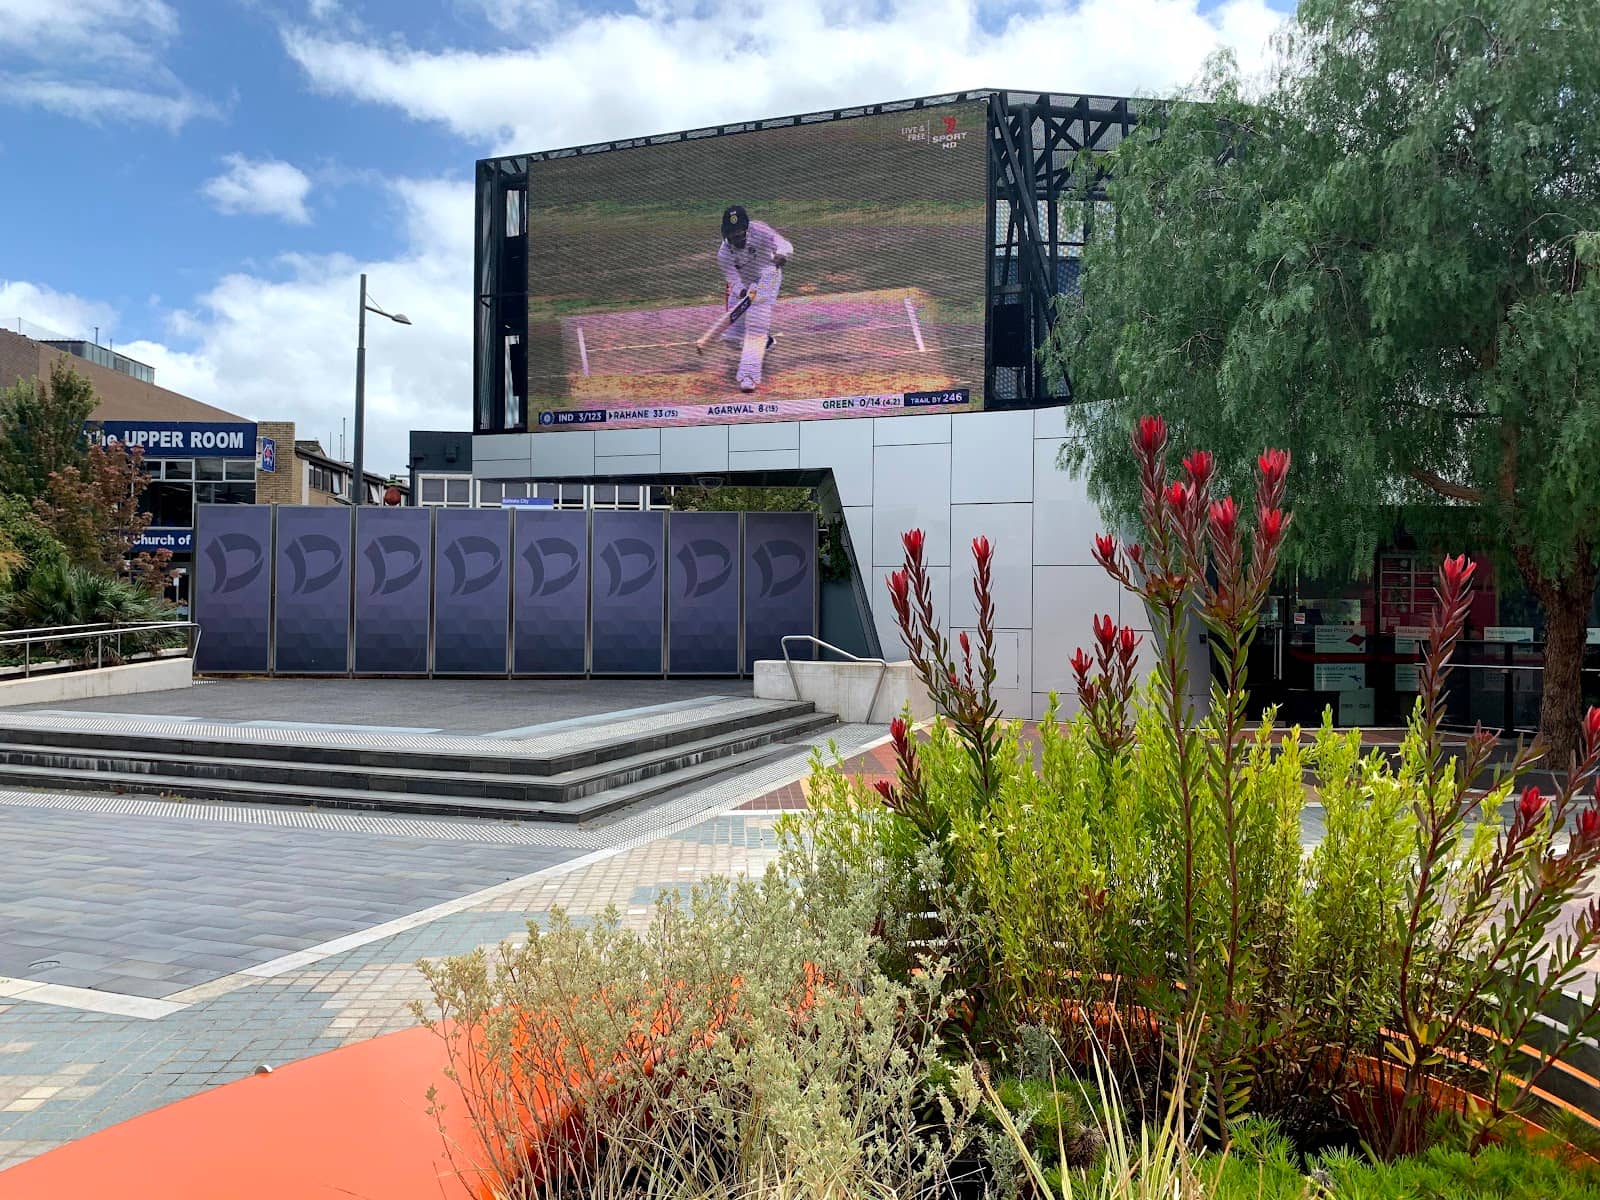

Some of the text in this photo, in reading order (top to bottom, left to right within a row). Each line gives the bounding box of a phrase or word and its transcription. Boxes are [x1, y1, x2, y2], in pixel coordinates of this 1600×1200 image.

[901, 126, 919, 135] LIVE
[932, 131, 968, 143] SPORT
[942, 141, 958, 150] HD
[910, 392, 963, 405] TRAIL BY 246
[707, 405, 755, 416] AGARWAL
[822, 400, 854, 410] GREEN
[558, 411, 602, 423] IND 3/123
[613, 409, 649, 420] RAHANE
[124, 430, 184, 448] UPPER
[190, 431, 244, 449] ROOM
[178, 534, 192, 545] of
